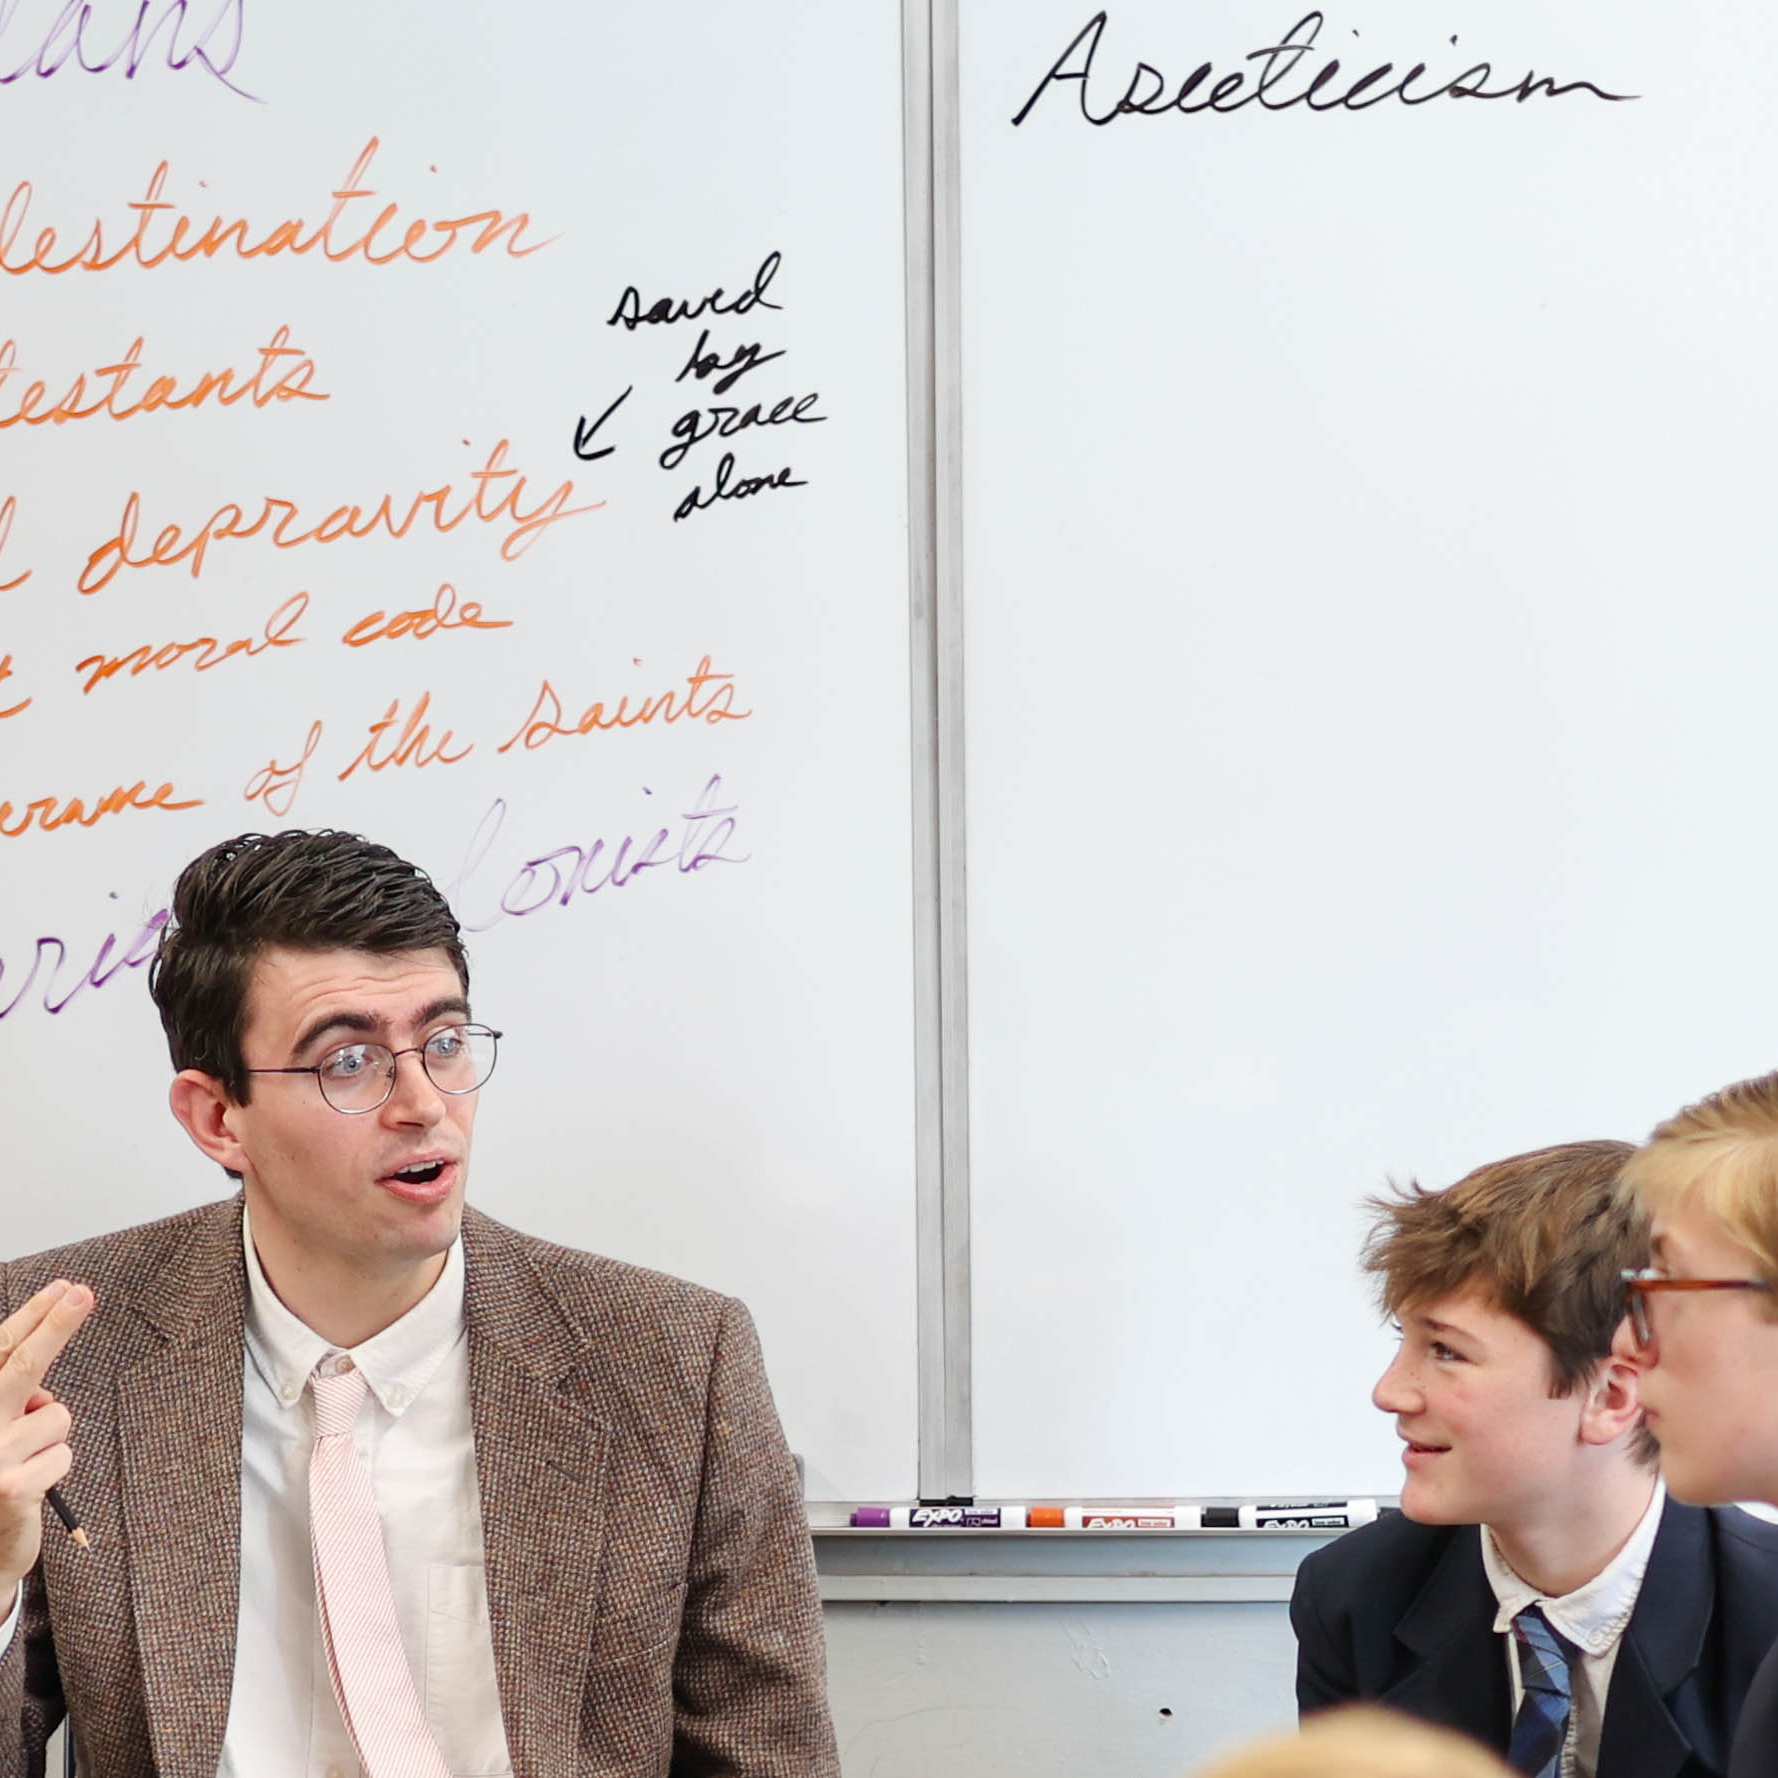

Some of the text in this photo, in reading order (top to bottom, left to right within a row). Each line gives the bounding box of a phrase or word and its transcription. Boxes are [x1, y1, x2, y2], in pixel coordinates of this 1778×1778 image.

[606, 250, 784, 331] saved
[674, 328, 787, 395] by
[658, 392, 828, 471] grace
[76, 439, 608, 596] depravity
[672, 451, 810, 523] alone
[75, 592, 310, 696] moral
[342, 584, 514, 648] code
[244, 722, 325, 812] of
[337, 691, 475, 784] the
[497, 655, 753, 754] saints
[447, 774, 752, 932] lonists
[912, 1508, 963, 1527] EXPO
